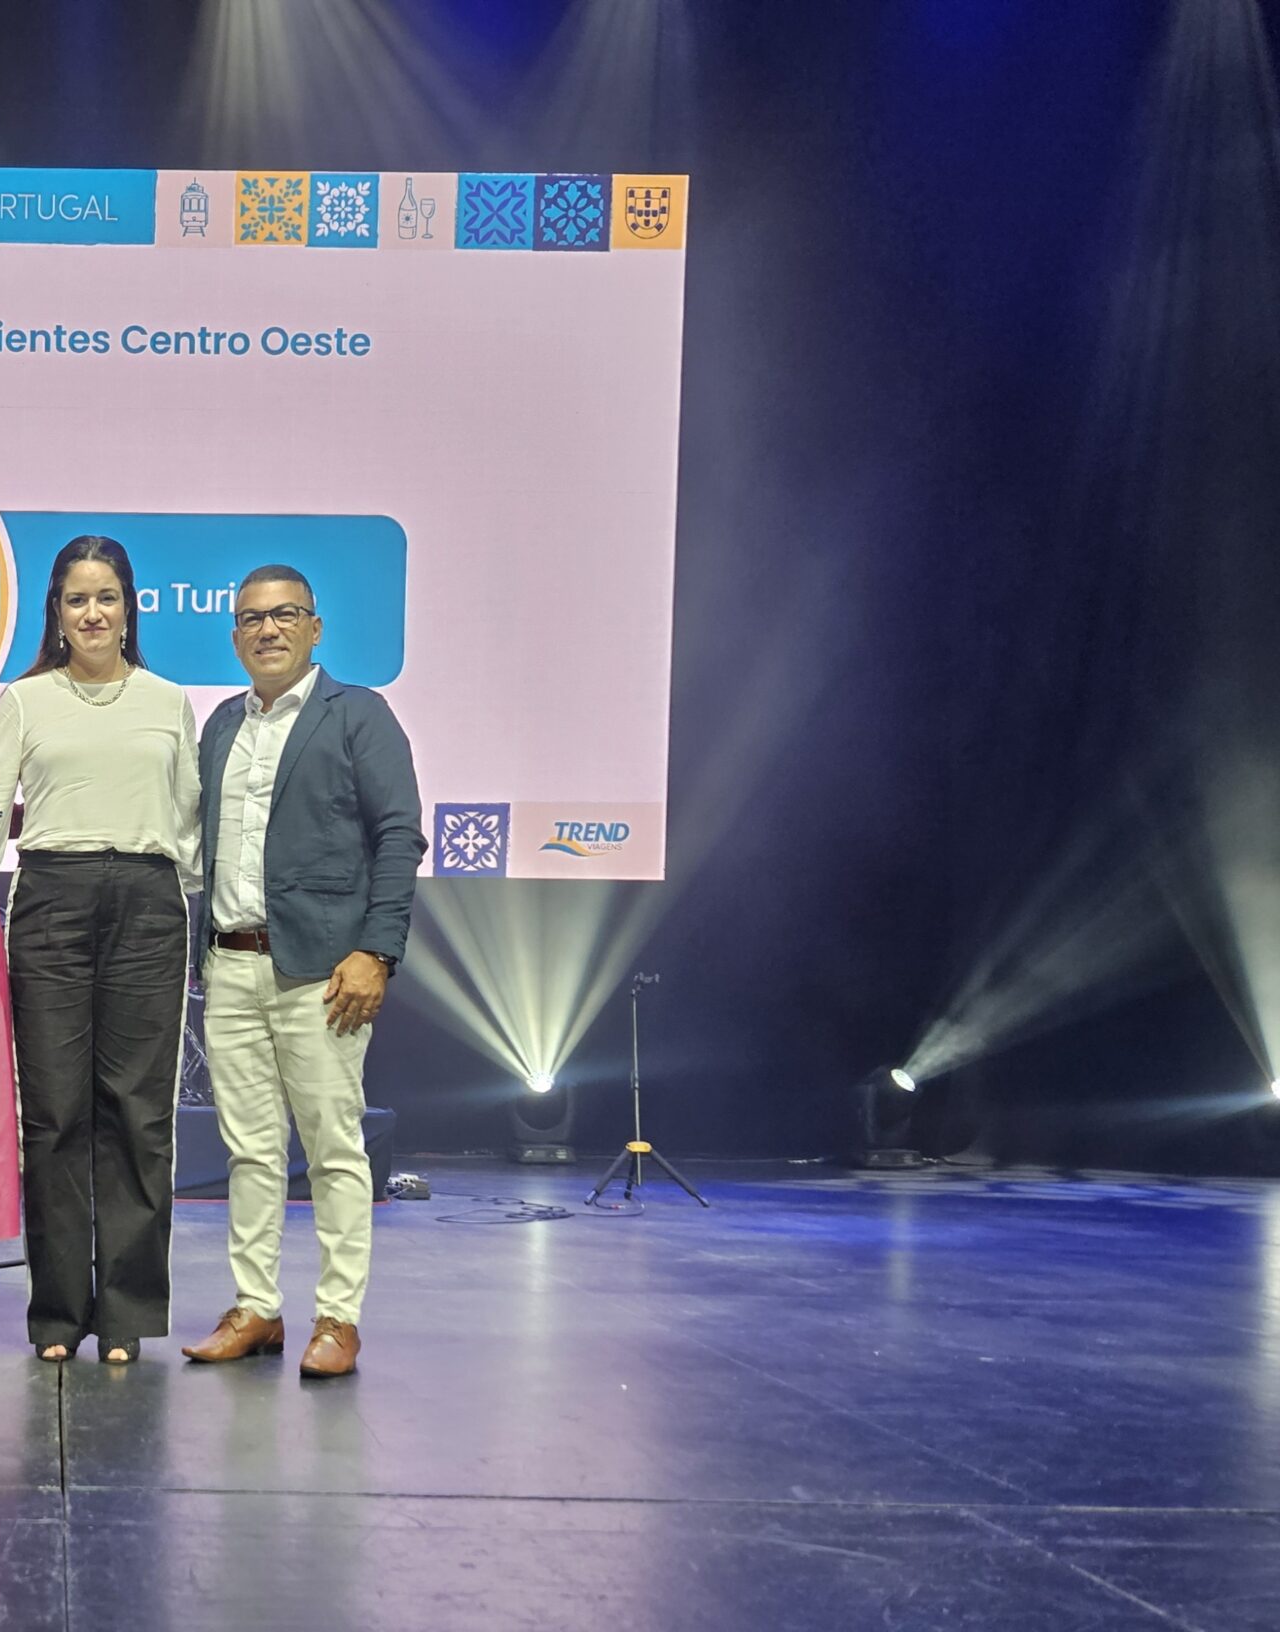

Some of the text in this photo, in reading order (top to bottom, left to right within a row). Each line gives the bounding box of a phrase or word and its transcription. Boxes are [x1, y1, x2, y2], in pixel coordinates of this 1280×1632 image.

[120, 325, 251, 356] Centro
[260, 326, 372, 357] Oeste
[137, 582, 235, 613] a Turi
[554, 821, 630, 842] TREND
[586, 843, 623, 851] VIAGENS
